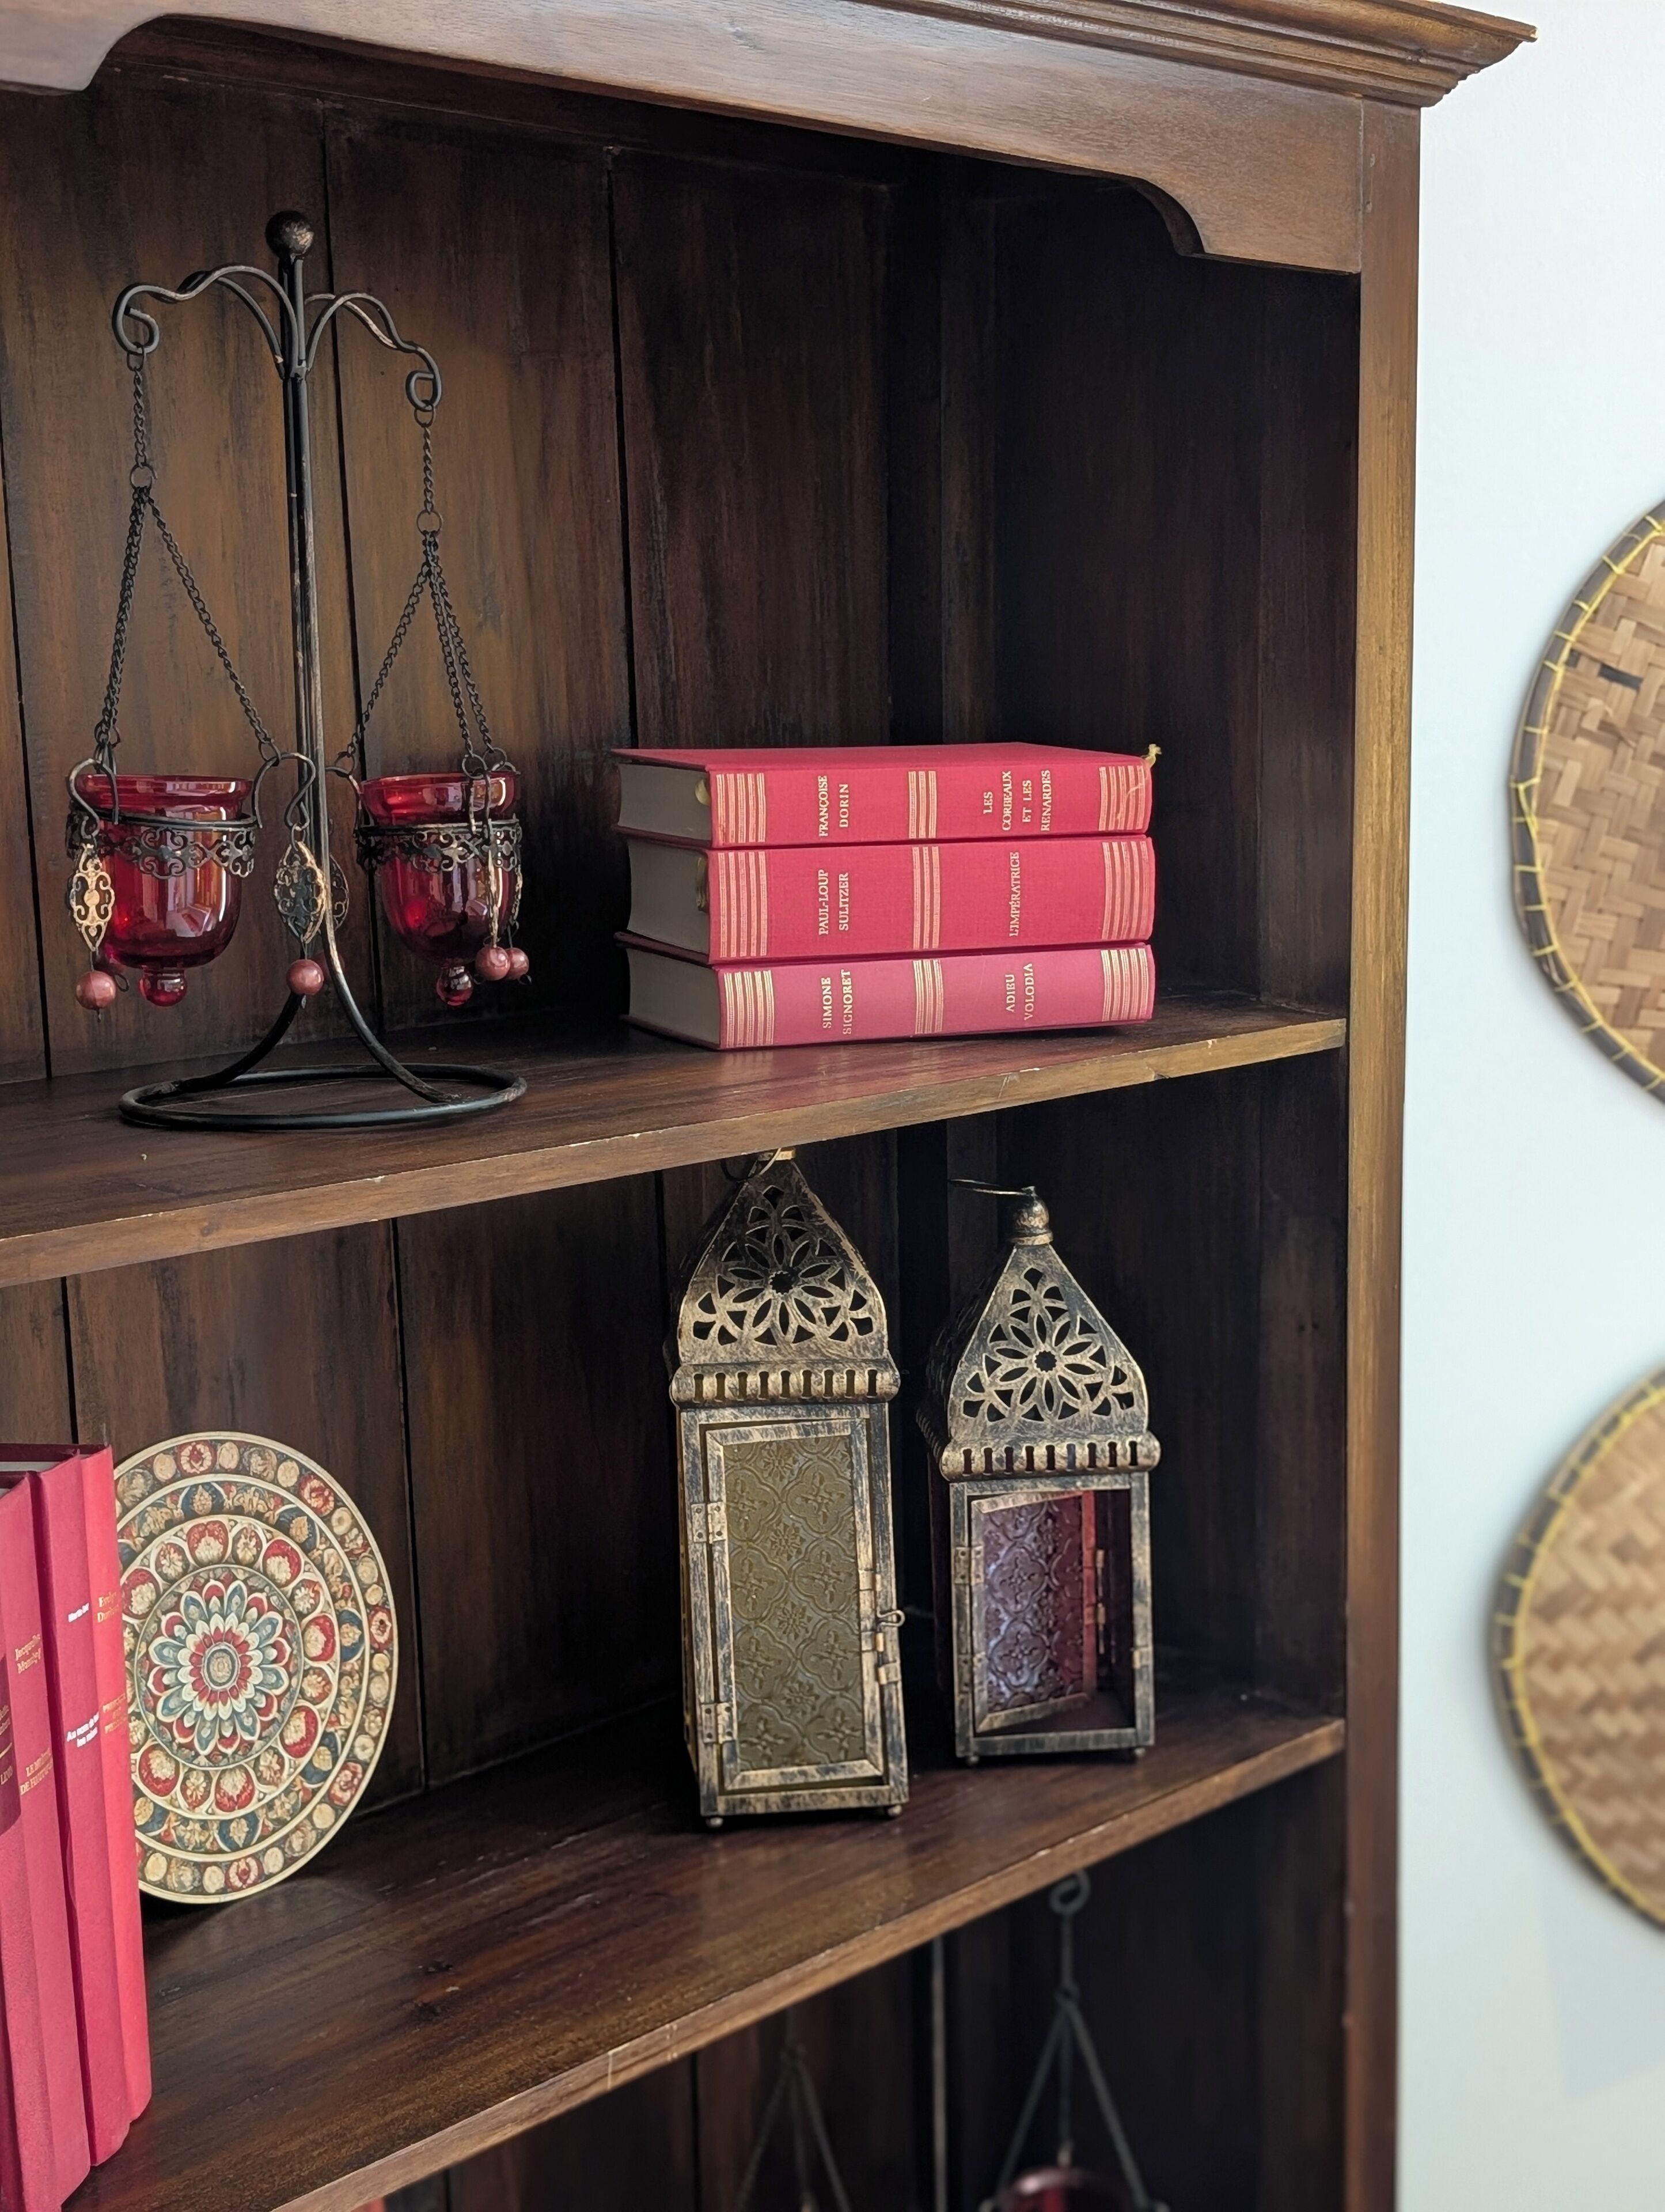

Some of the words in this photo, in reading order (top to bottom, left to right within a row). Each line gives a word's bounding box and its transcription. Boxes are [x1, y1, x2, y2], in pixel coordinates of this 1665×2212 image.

[818, 775, 829, 836] FRANÇOISE
[839, 784, 849, 828] DORIN
[983, 791, 993, 815] LES
[1002, 771, 1012, 831] CORBEAUX
[1022, 780, 1032, 801] LES
[1022, 806, 1032, 823] ET
[1041, 770, 1052, 831] RENARDES
[818, 869, 829, 935] PAUL-LOUP
[839, 872, 849, 931] SULITZER
[1008, 852, 1021, 937] L'IMPÉRATRICE
[821, 977, 832, 1028] SIMONE
[841, 969, 853, 1035] SIGNORET
[1005, 974, 1015, 1012] ADIEU
[1023, 963, 1034, 1020] VOLODIA
